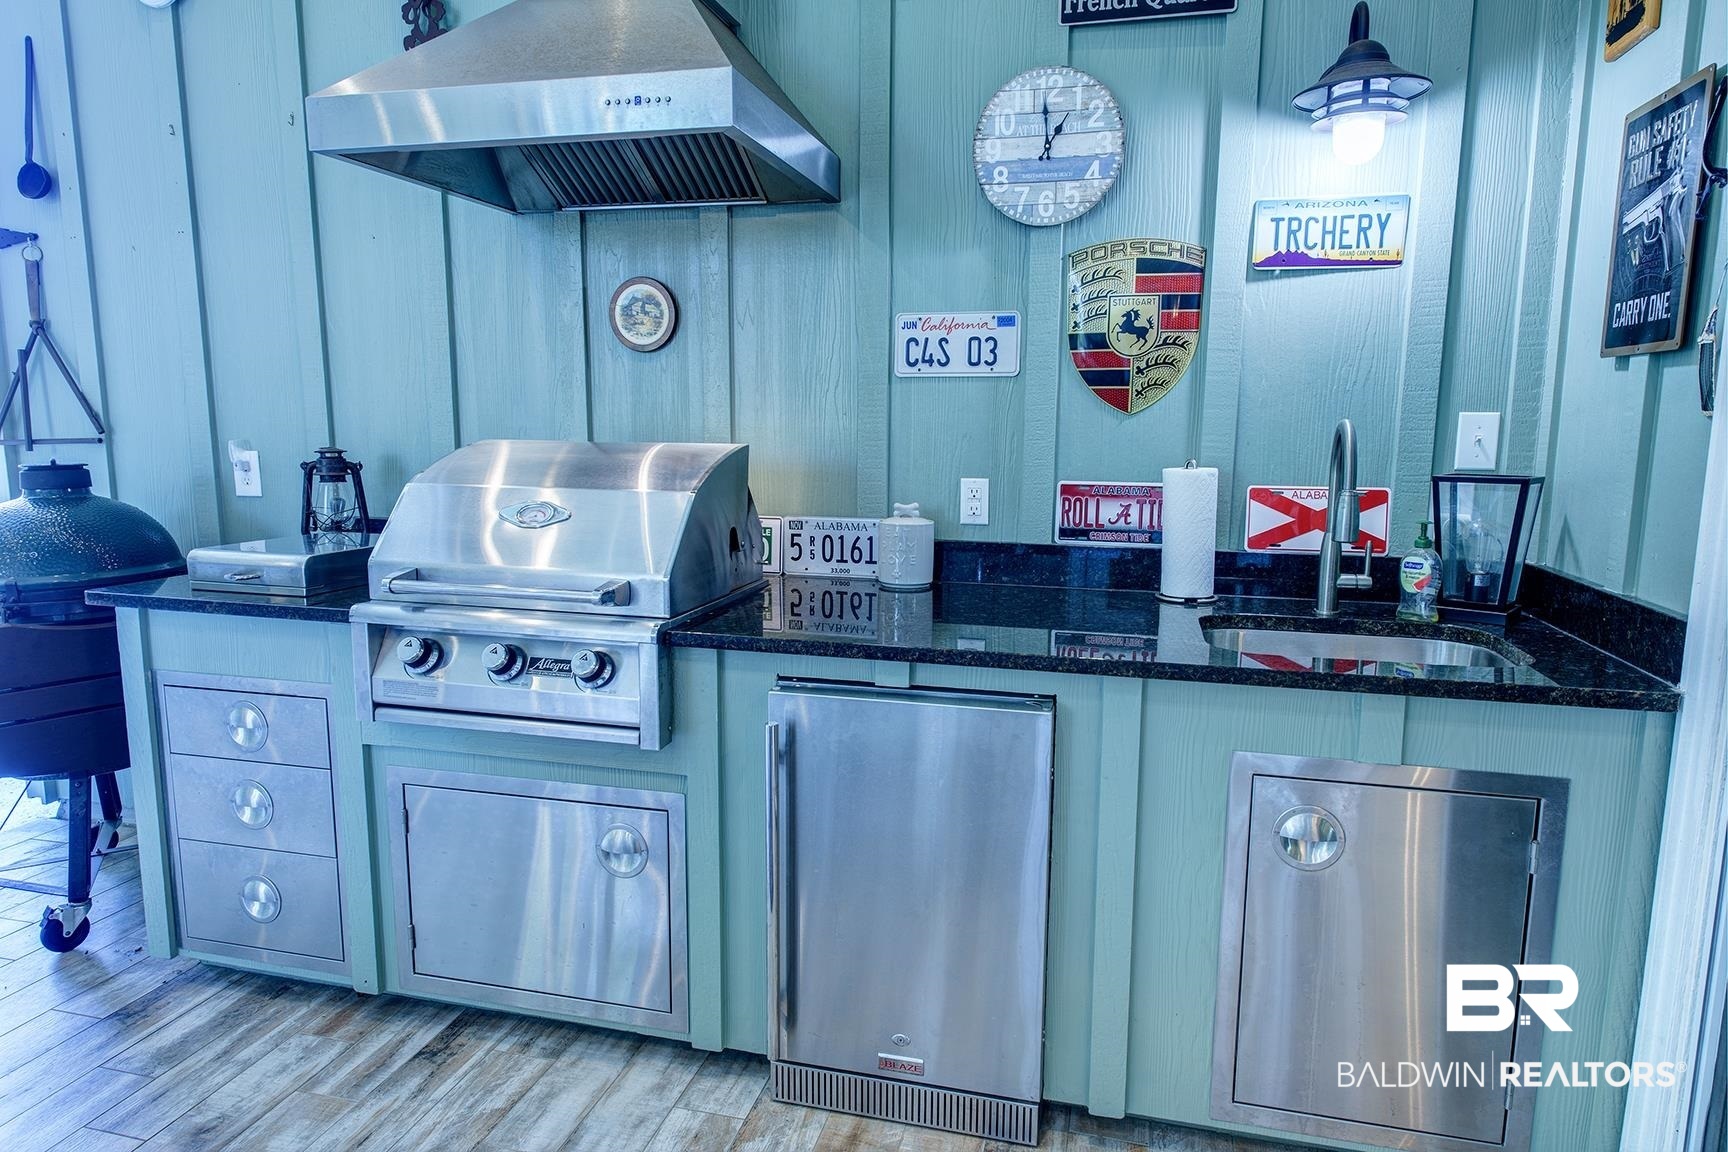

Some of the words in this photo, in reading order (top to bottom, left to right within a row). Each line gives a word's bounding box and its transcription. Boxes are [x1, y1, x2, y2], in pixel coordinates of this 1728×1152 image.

[1036, 74, 1064, 103] 12
[1072, 83, 1084, 110] 1
[994, 108, 1016, 136] 10
[1088, 99, 1105, 128] 2
[1627, 126, 1651, 160] GUN
[1652, 99, 1699, 146] SAFETY
[985, 138, 1001, 164] 9
[1096, 131, 1113, 158] 3
[993, 166, 1009, 193] 8
[1084, 160, 1102, 187] 4
[1628, 146, 1664, 190] RULE
[1014, 186, 1031, 214] 7
[1038, 190, 1055, 218] 6
[1063, 183, 1080, 210] 5
[1294, 199, 1369, 209] ARIZONA
[1270, 212, 1392, 251] TRCHERY
[1071, 241, 1205, 269] PORSCHE
[1112, 298, 1156, 307] STUTTGART
[1612, 296, 1649, 329] CARRY
[1647, 291, 1671, 322] ONE.
[901, 321, 918, 330] JUN
[920, 316, 997, 335] California
[905, 336, 951, 367] C4S
[967, 336, 998, 366] 03
[1092, 486, 1150, 497] ALABAMA
[1291, 490, 1329, 500] ALABA
[814, 522, 868, 532] ALABAMA
[1061, 496, 1105, 529] ROLL
[1136, 498, 1163, 531] TI
[790, 533, 803, 561] 5
[822, 534, 877, 565] 0161
[1088, 531, 1129, 541] CRIMSON
[1129, 533, 1151, 542] TIDE
[529, 658, 571, 672] Allegra
[884, 1060, 922, 1072] BLAZE
